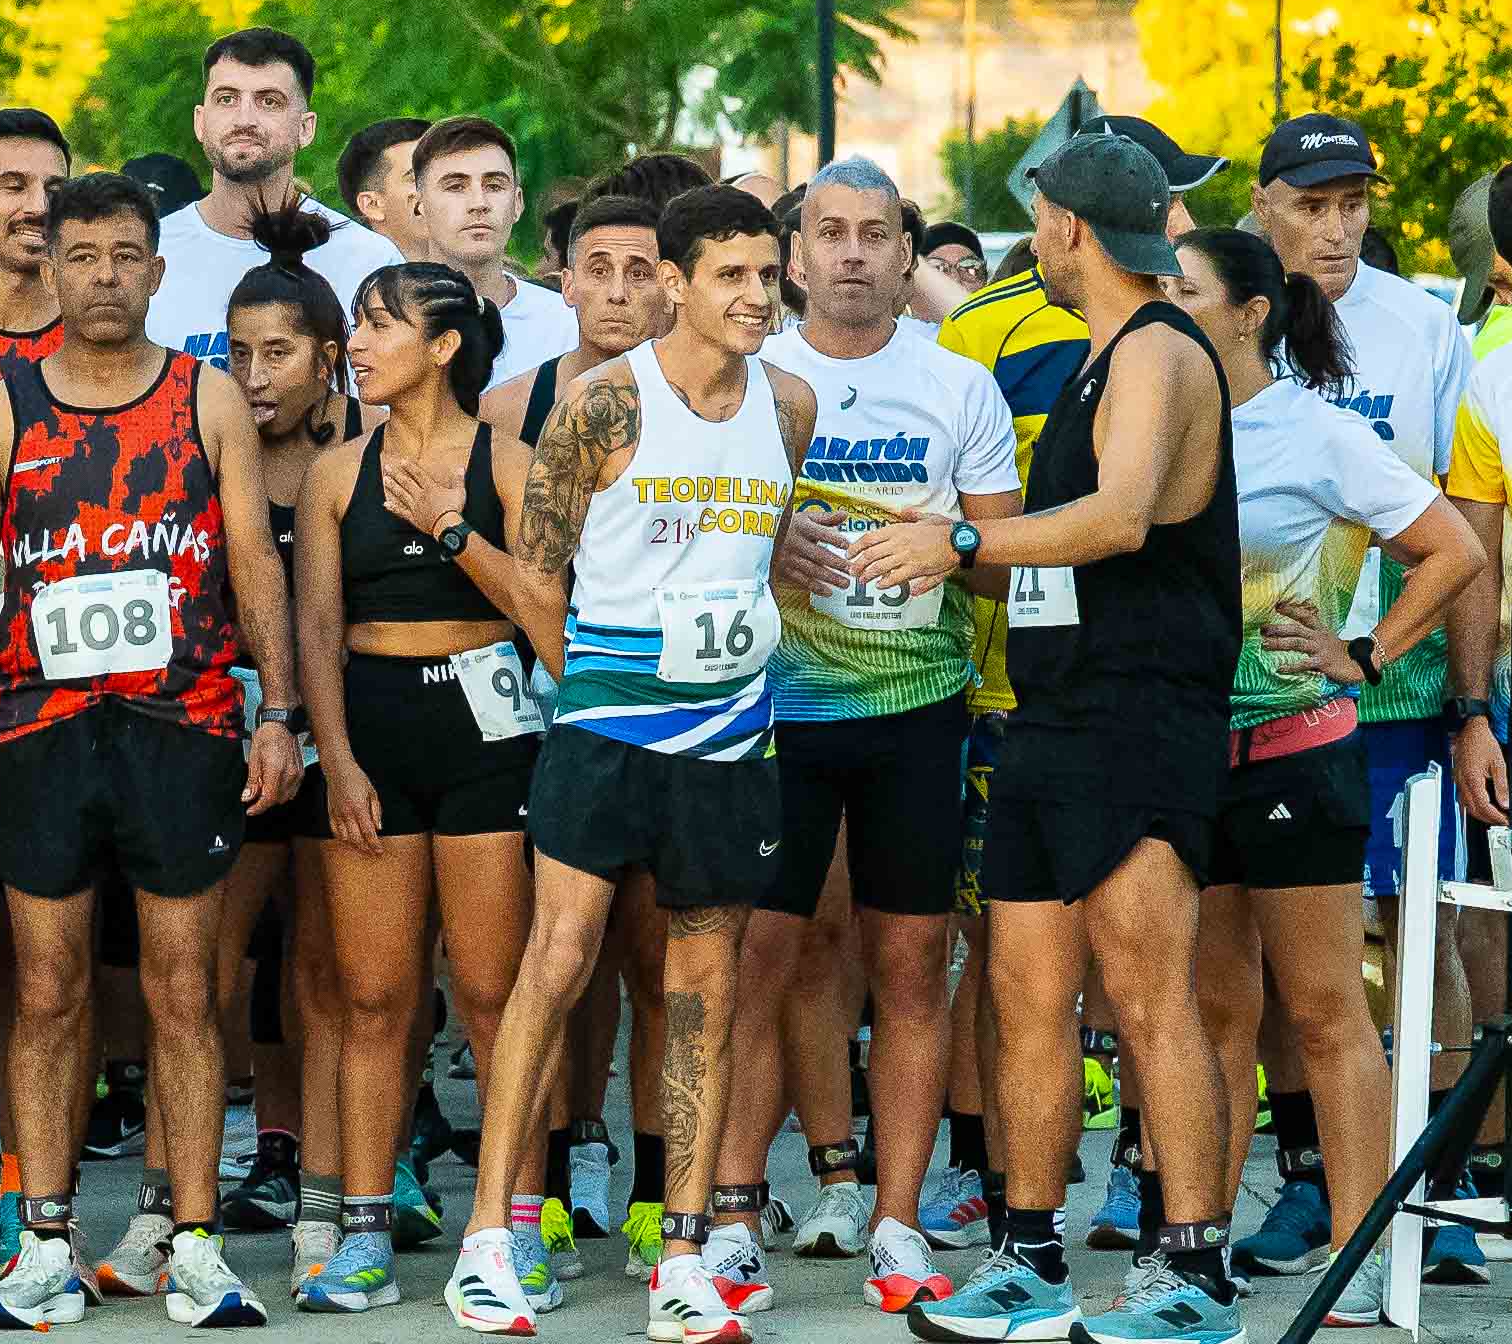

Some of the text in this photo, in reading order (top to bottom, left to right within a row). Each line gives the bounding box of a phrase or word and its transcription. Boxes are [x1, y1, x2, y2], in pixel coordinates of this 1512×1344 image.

[806, 432, 930, 461] ARATÓN
[801, 462, 929, 484] ORTONDO
[101, 511, 210, 562] CAÑAS
[698, 508, 782, 538] CORR
[403, 541, 424, 555] alo
[46, 599, 158, 655] 108
[694, 609, 754, 659] 16
